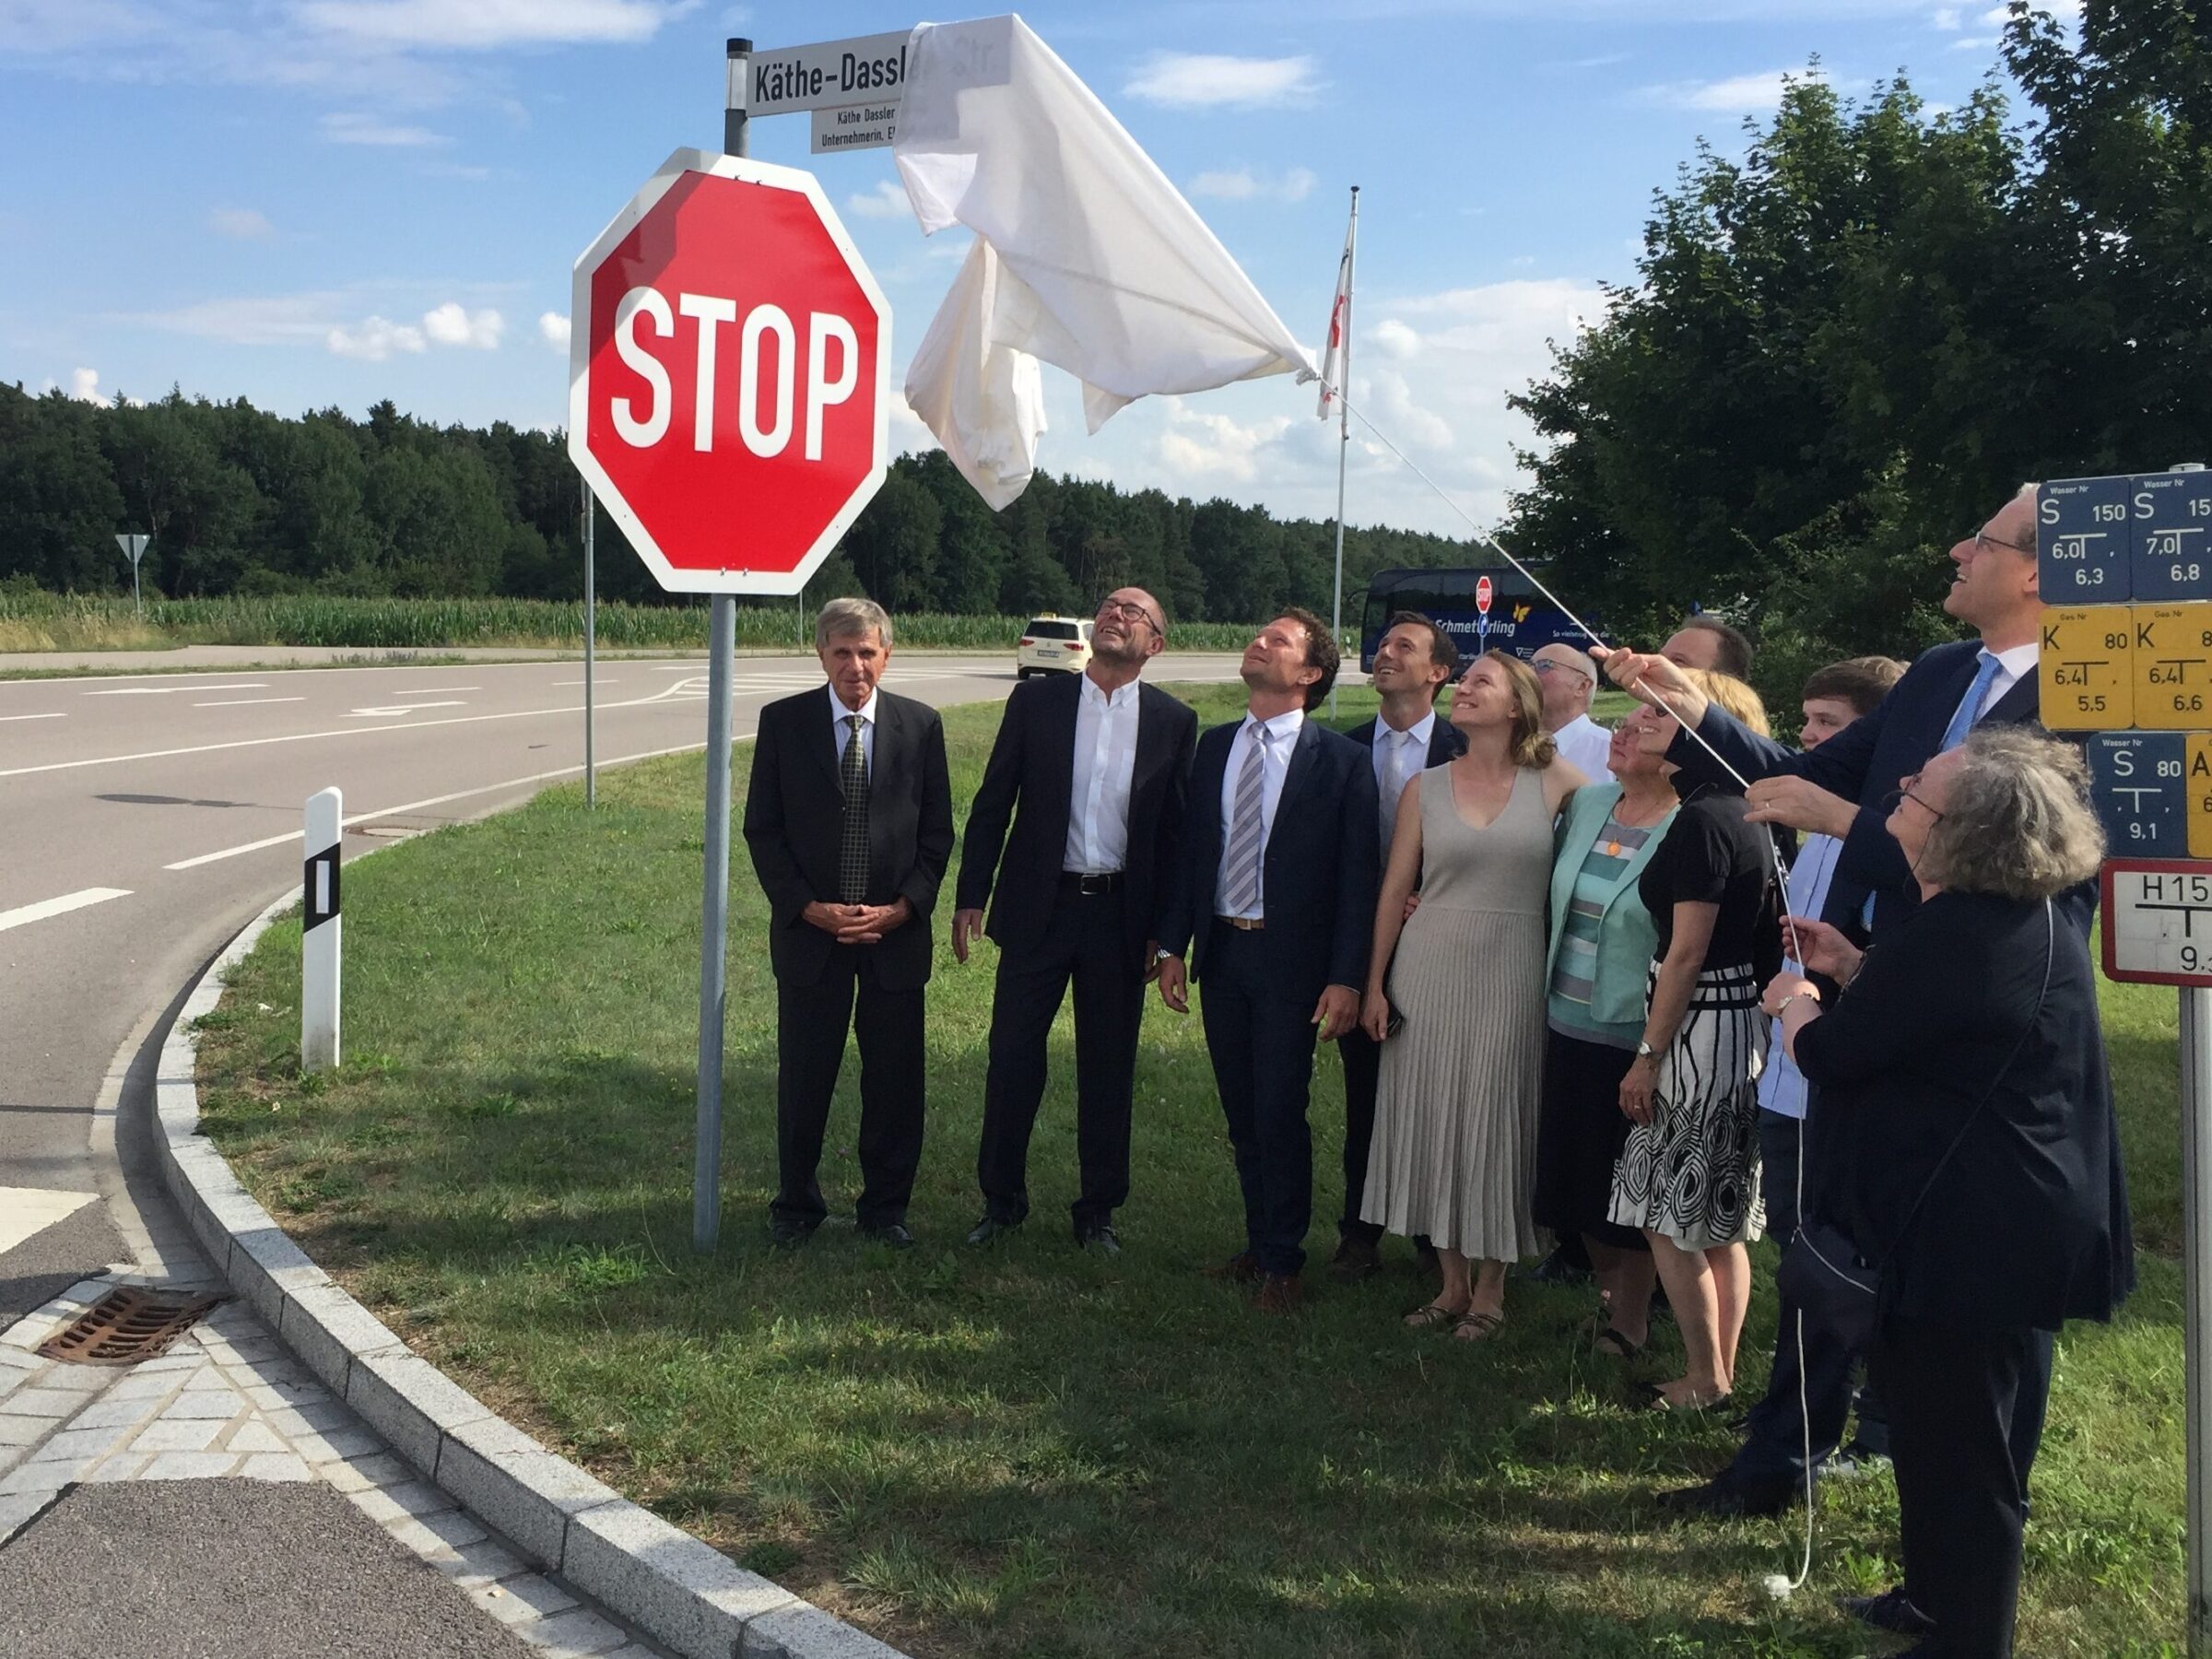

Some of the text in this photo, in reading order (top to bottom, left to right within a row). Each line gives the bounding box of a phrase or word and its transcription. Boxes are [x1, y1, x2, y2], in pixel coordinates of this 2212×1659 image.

[837, 106, 895, 124] Käthe Dassler
[821, 129, 884, 147] Unternehmerin,
[611, 287, 858, 461] STOP
[2050, 486, 2077, 495] Wasser
[2144, 478, 2184, 488] Wasser Nr
[2041, 499, 2126, 524] S 150
[2133, 492, 2154, 519] S
[2053, 542, 2080, 559] 6,0
[2146, 537, 2175, 555] 7,0
[2076, 568, 2103, 585] 6,3
[2171, 563, 2200, 582] 6,8
[1435, 618, 1515, 637] Schmettrling
[2136, 622, 2155, 648] K
[2043, 625, 2127, 651] K 80
[2054, 669, 2082, 686] 6,4
[2149, 667, 2177, 684] 6,4
[2078, 695, 2106, 712] 5,5
[2174, 694, 2203, 712] 6,6
[2102, 738, 2130, 747] Wasser
[2113, 750, 2181, 777] S 80
[2192, 750, 2211, 776] A
[2129, 822, 2157, 840] 9,1
[2181, 946, 2212, 973] 9,
